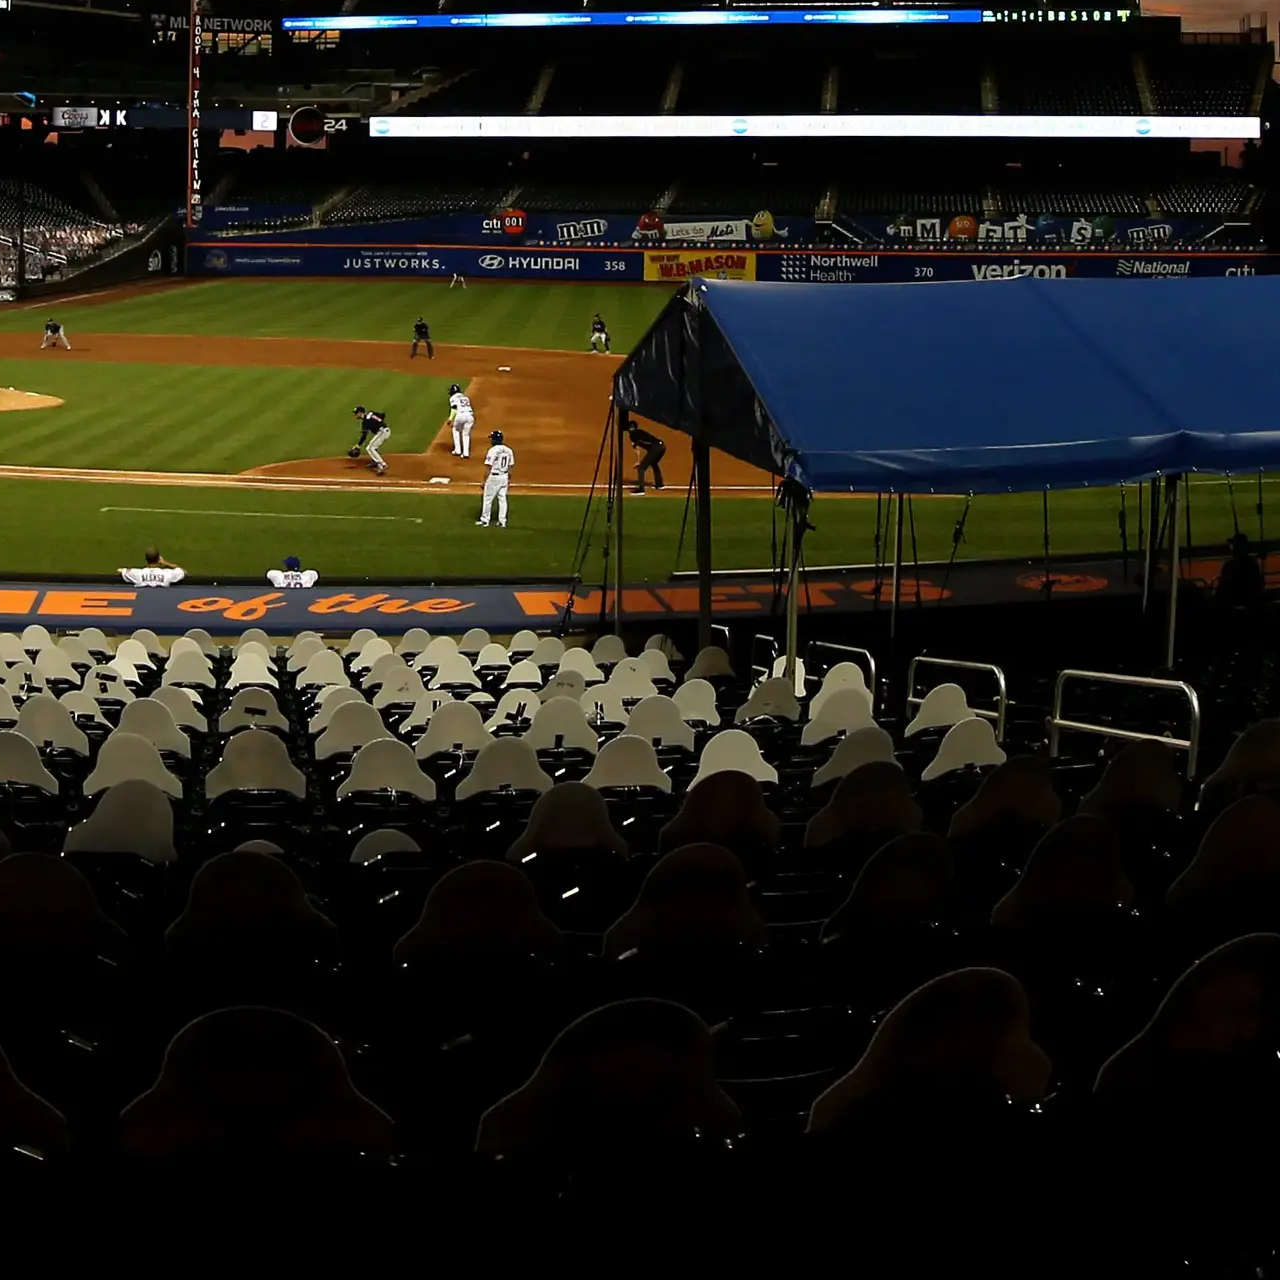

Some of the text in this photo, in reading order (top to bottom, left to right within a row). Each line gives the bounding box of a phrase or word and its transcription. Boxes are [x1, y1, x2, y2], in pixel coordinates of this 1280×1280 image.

[204, 19, 272, 31] NETWORK
[194, 16, 202, 55] ROOT
[193, 67, 200, 79] 4
[62, 109, 89, 122] Coors
[116, 109, 127, 125] K
[324, 120, 348, 131] 24
[483, 216, 523, 229] citi 001
[920, 221, 1089, 242] M S
[343, 258, 446, 269] JUSTWORKS.
[508, 256, 579, 270] HYUNDAI
[604, 260, 626, 271] 358
[810, 254, 879, 267] Northwell
[1132, 260, 1190, 274] National
[810, 270, 852, 282] Health
[914, 266, 934, 278] 370
[971, 259, 1067, 281] verizon
[460, 397, 470, 407] 52
[501, 455, 506, 468] 0
[177, 592, 287, 621] of
[308, 592, 477, 615] the
[513, 576, 955, 617] METS
